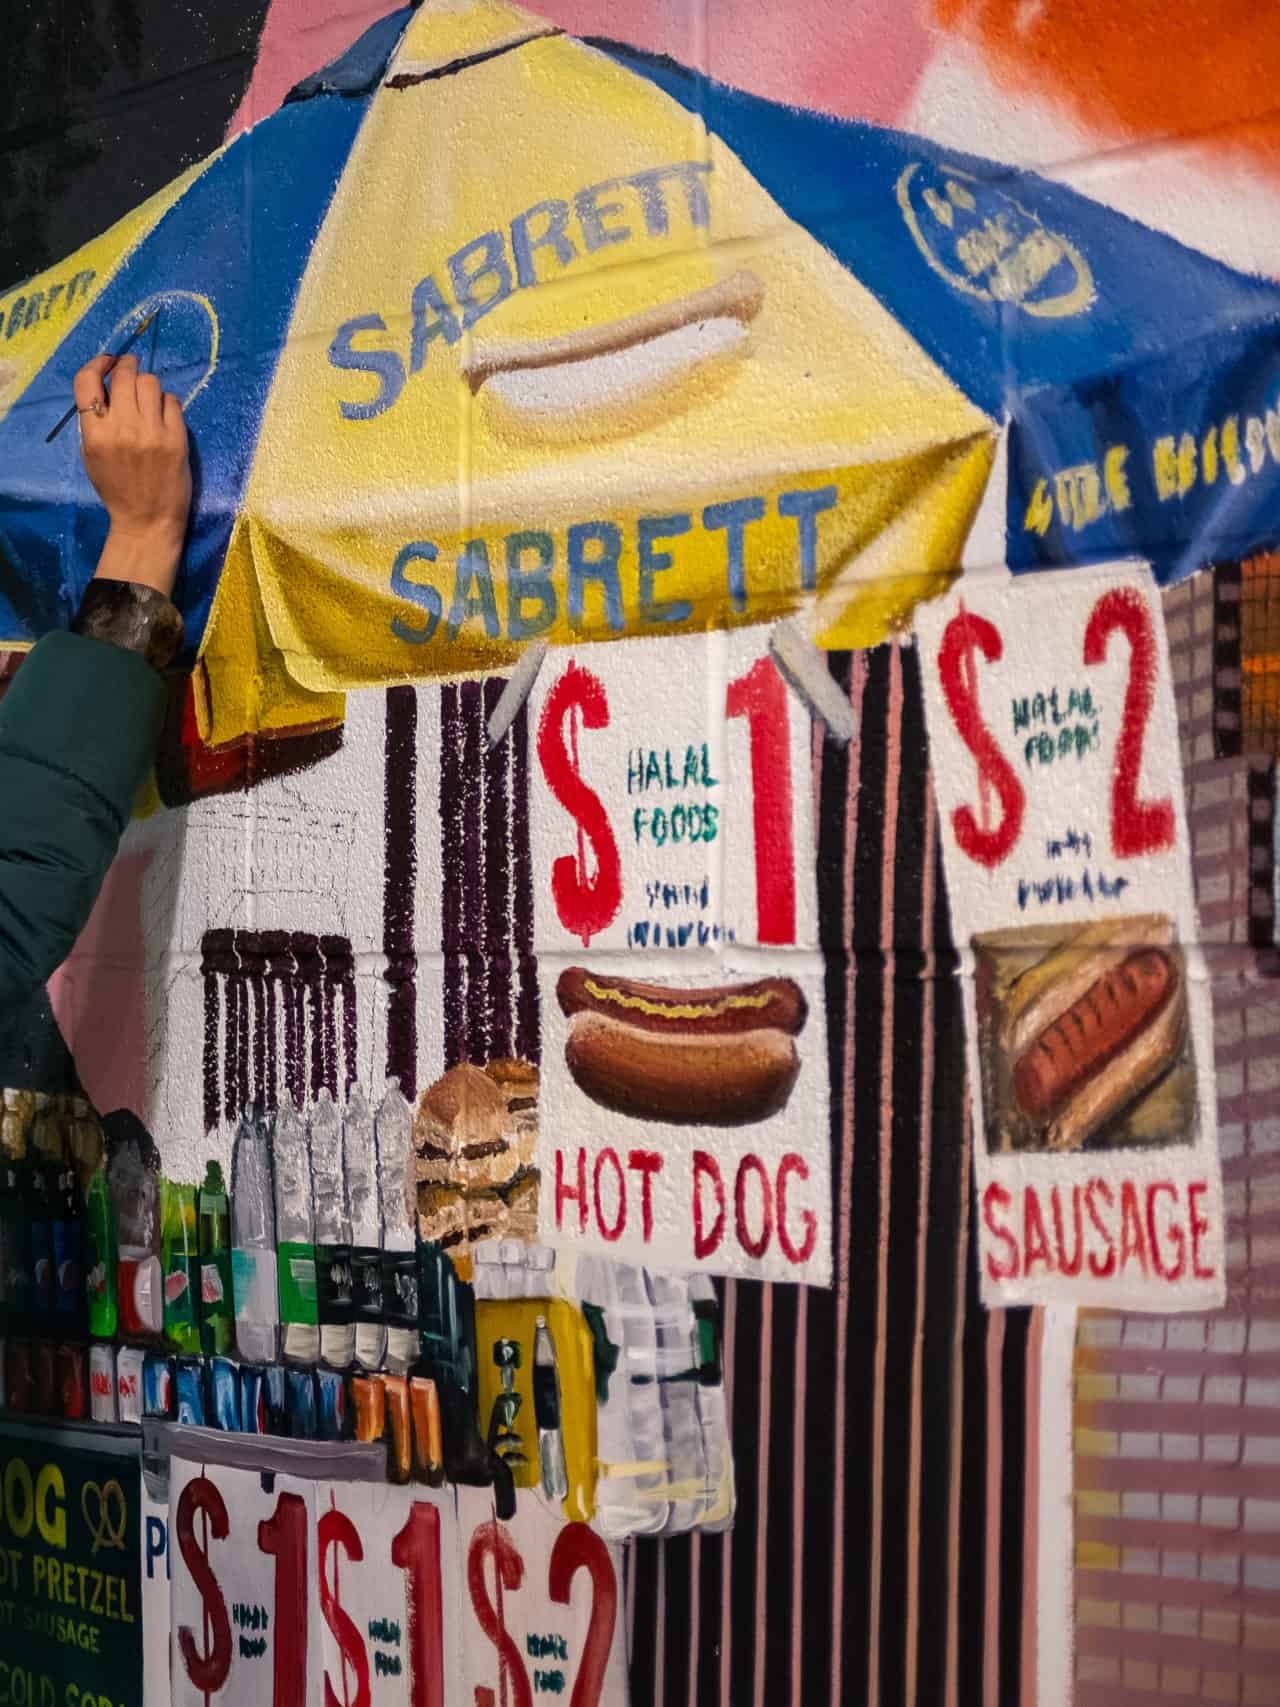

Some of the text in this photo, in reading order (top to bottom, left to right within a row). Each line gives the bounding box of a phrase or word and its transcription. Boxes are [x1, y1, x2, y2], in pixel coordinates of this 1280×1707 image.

[327, 160, 714, 421] SABRETT
[390, 485, 839, 645] SABRETT
[627, 742, 719, 794] HALAL
[633, 802, 719, 848] FOODS
[554, 1146, 817, 1264] HOT DOG
[982, 1177, 1215, 1283] SAUSAGE
[32, 1555, 135, 1624] PRETZEL
